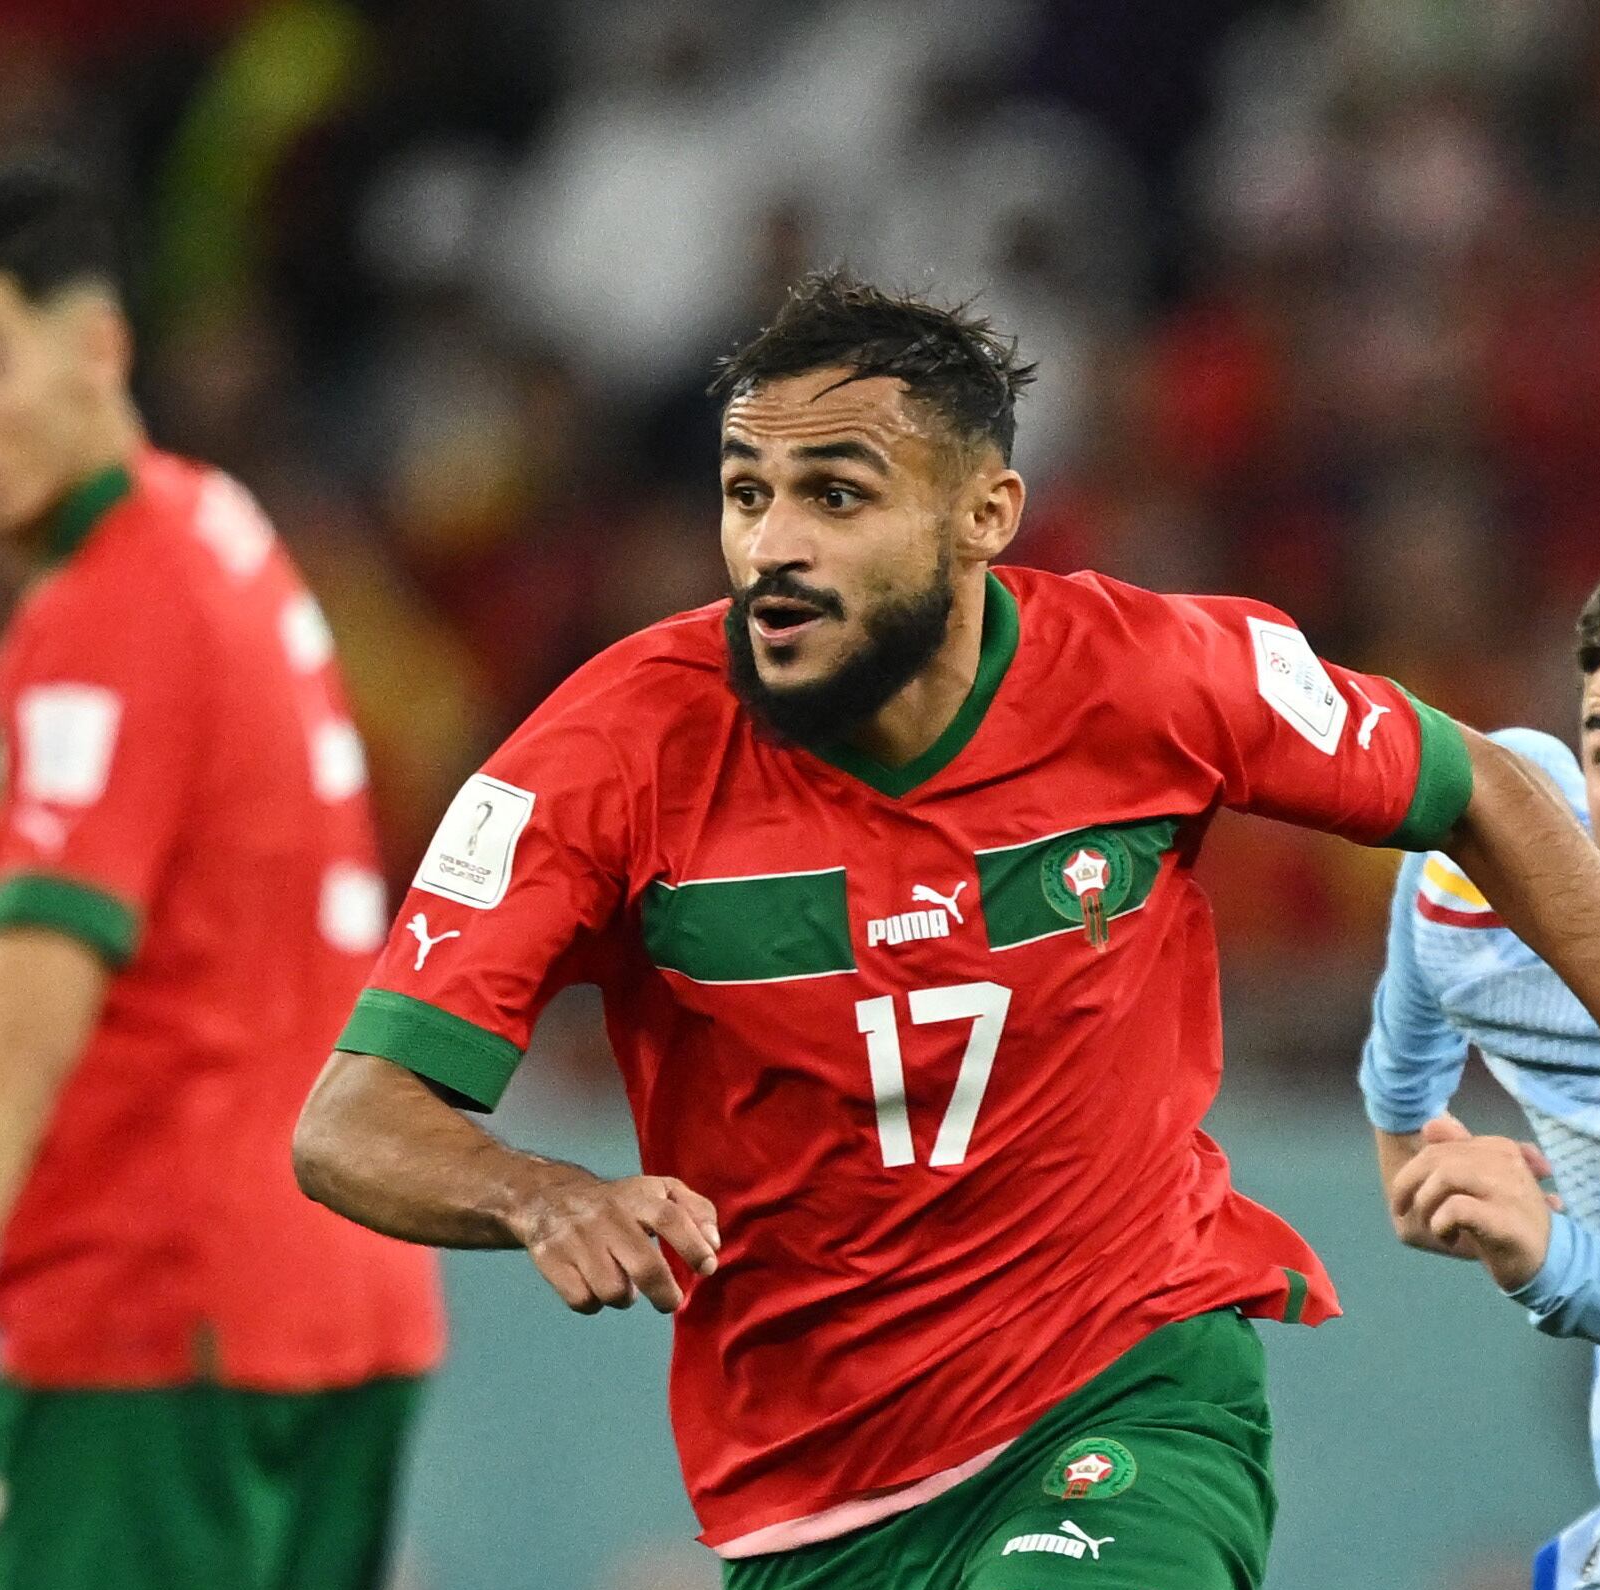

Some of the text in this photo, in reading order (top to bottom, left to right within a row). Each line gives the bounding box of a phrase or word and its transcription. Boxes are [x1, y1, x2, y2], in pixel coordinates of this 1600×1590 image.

[867, 909, 950, 947] PUMA
[855, 981, 1013, 1168] 17
[1001, 1533, 1087, 1560] PUMA
